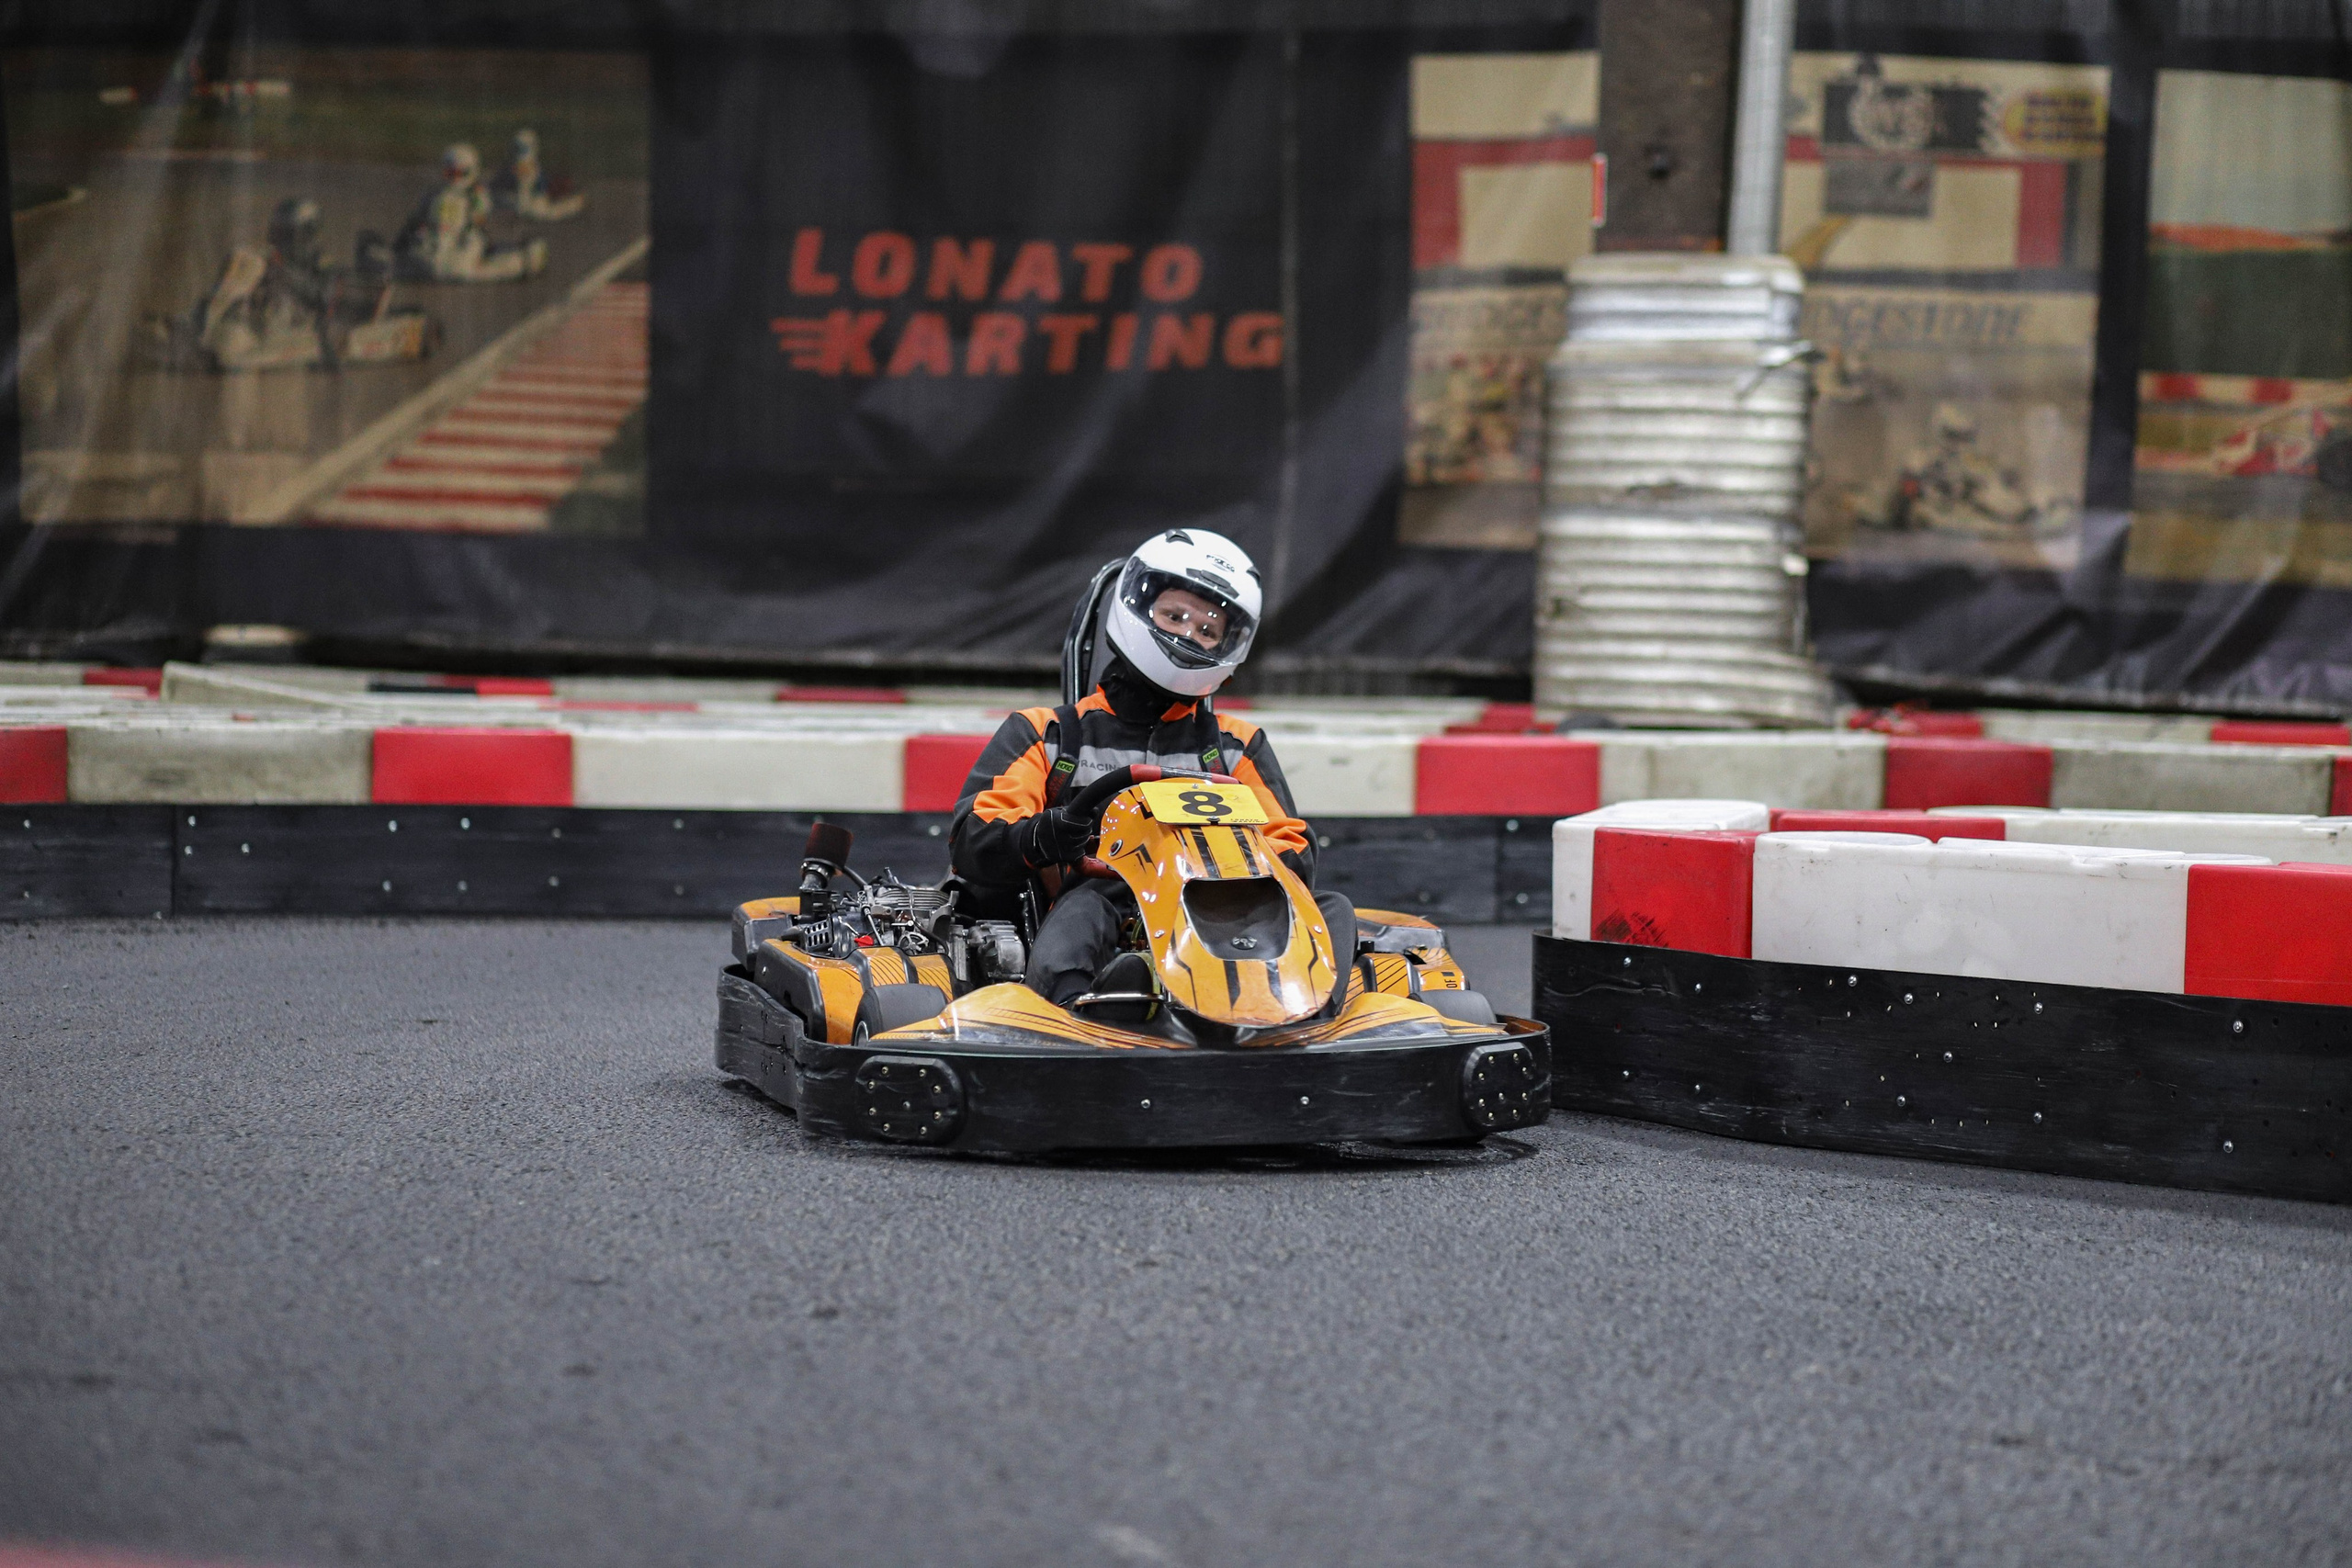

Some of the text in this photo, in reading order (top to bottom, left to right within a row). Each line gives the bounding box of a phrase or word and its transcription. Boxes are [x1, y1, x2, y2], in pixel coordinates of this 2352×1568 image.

[789, 227, 1203, 302] LONATO
[808, 310, 1285, 376] KARTING
[1080, 759, 1123, 773] RACIN
[1178, 791, 1233, 817] 8
